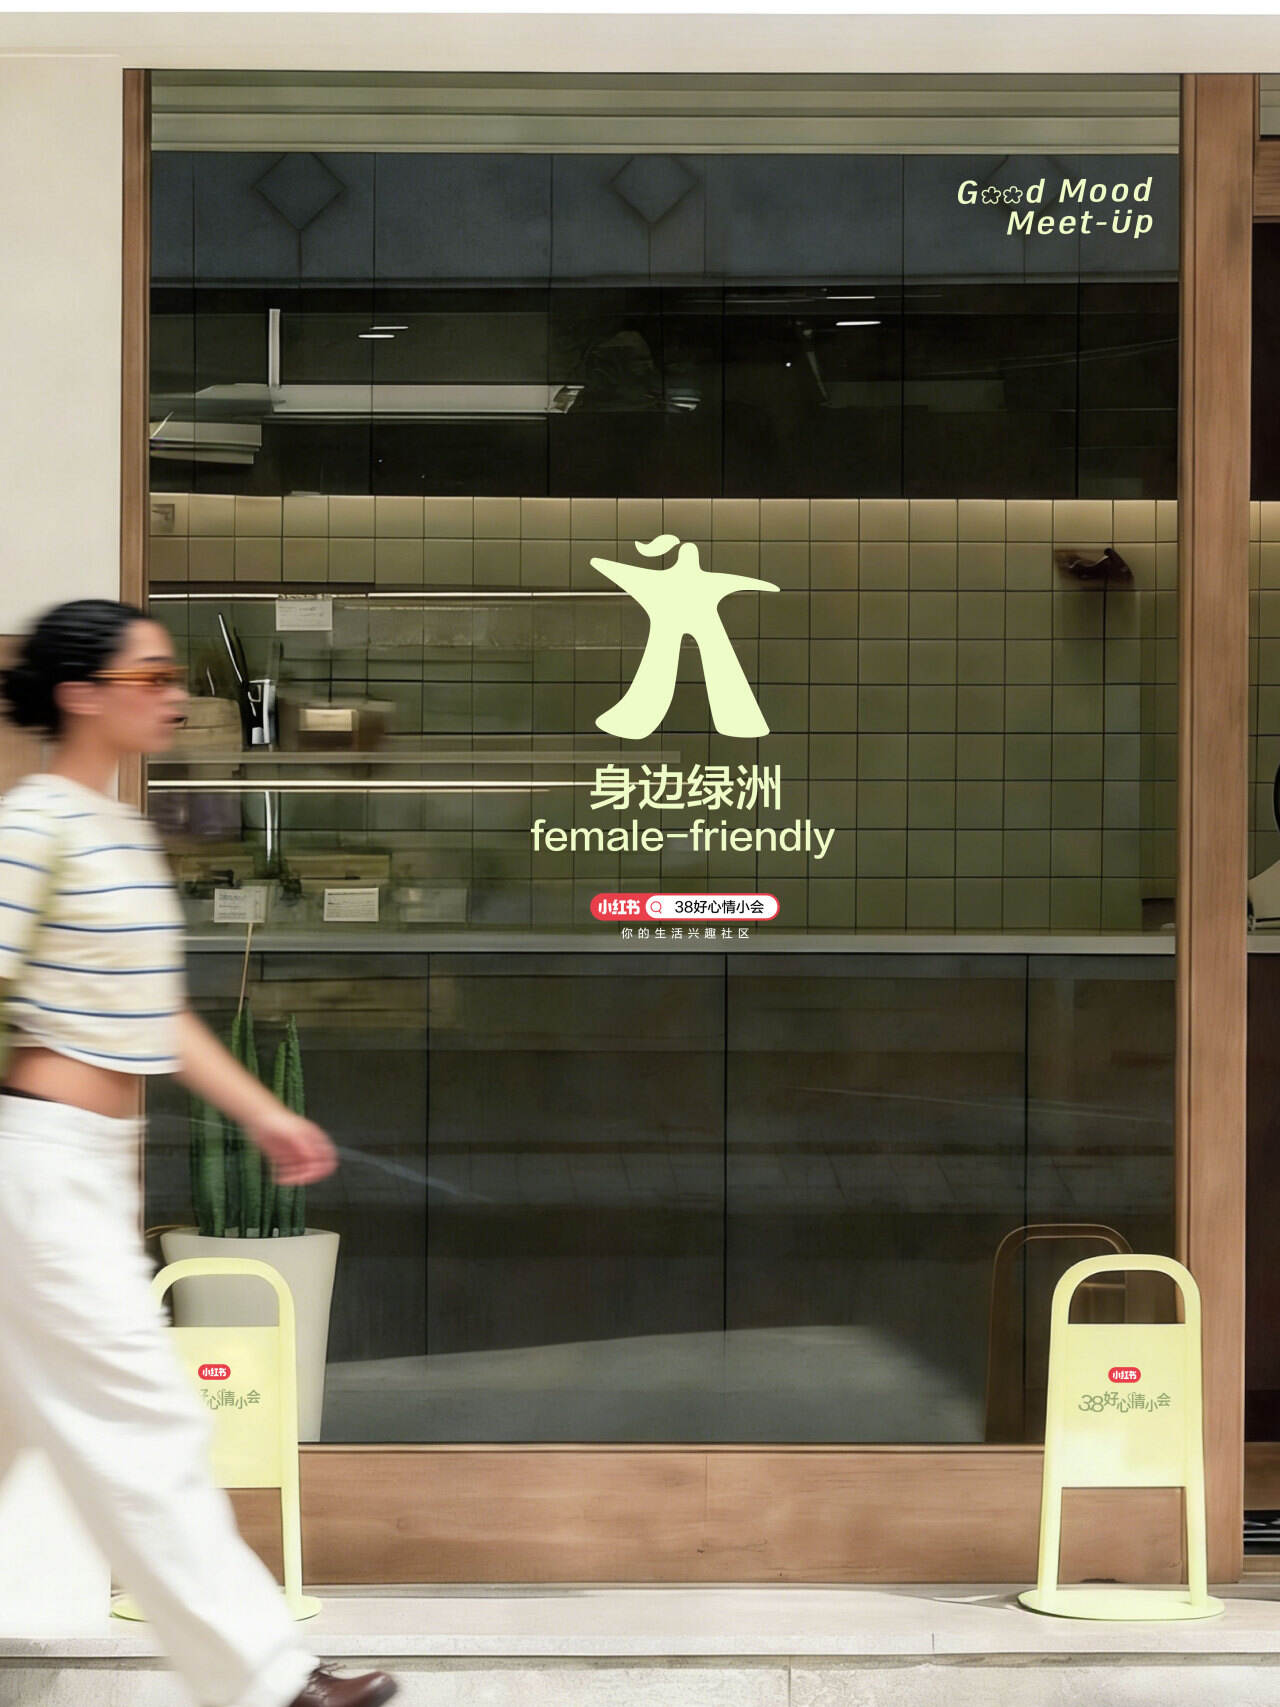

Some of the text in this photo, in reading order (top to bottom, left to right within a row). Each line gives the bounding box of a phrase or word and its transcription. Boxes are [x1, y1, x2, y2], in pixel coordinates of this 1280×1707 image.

[1058, 176, 1153, 203] Mood
[590, 763, 781, 811] 身边绿洲
[530, 819, 836, 860] female-friendly
[598, 899, 764, 915] 小红书 38好心情小会
[621, 927, 750, 940] 你的生活兴趣社区
[202, 1367, 227, 1377] 小红书
[1112, 1370, 1137, 1380] 小红书
[1078, 1391, 1171, 1413] 38好心情小会
